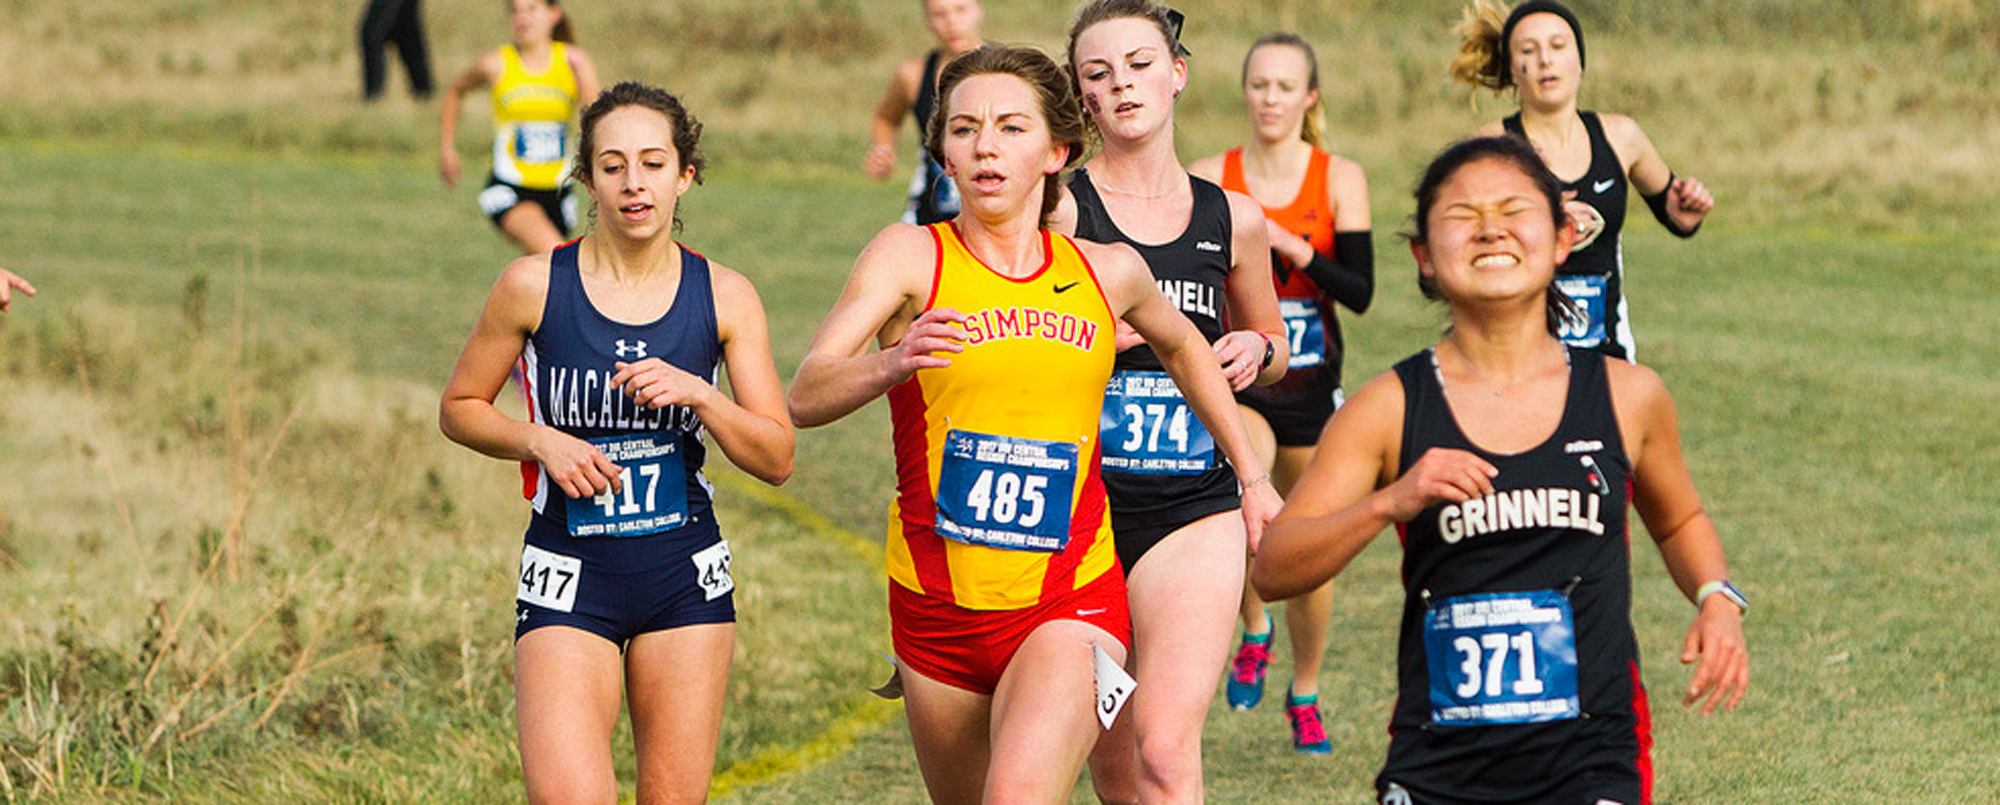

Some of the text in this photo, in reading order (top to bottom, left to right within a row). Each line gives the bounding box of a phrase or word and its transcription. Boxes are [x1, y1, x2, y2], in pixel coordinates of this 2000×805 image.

[965, 308, 1099, 352] SIMPSON
[1122, 404, 1188, 453] 374
[594, 463, 661, 517] 417
[966, 468, 1048, 528] 485
[1438, 487, 1605, 544] GRINNELL
[521, 560, 574, 600] 417
[1453, 630, 1544, 699] 371
